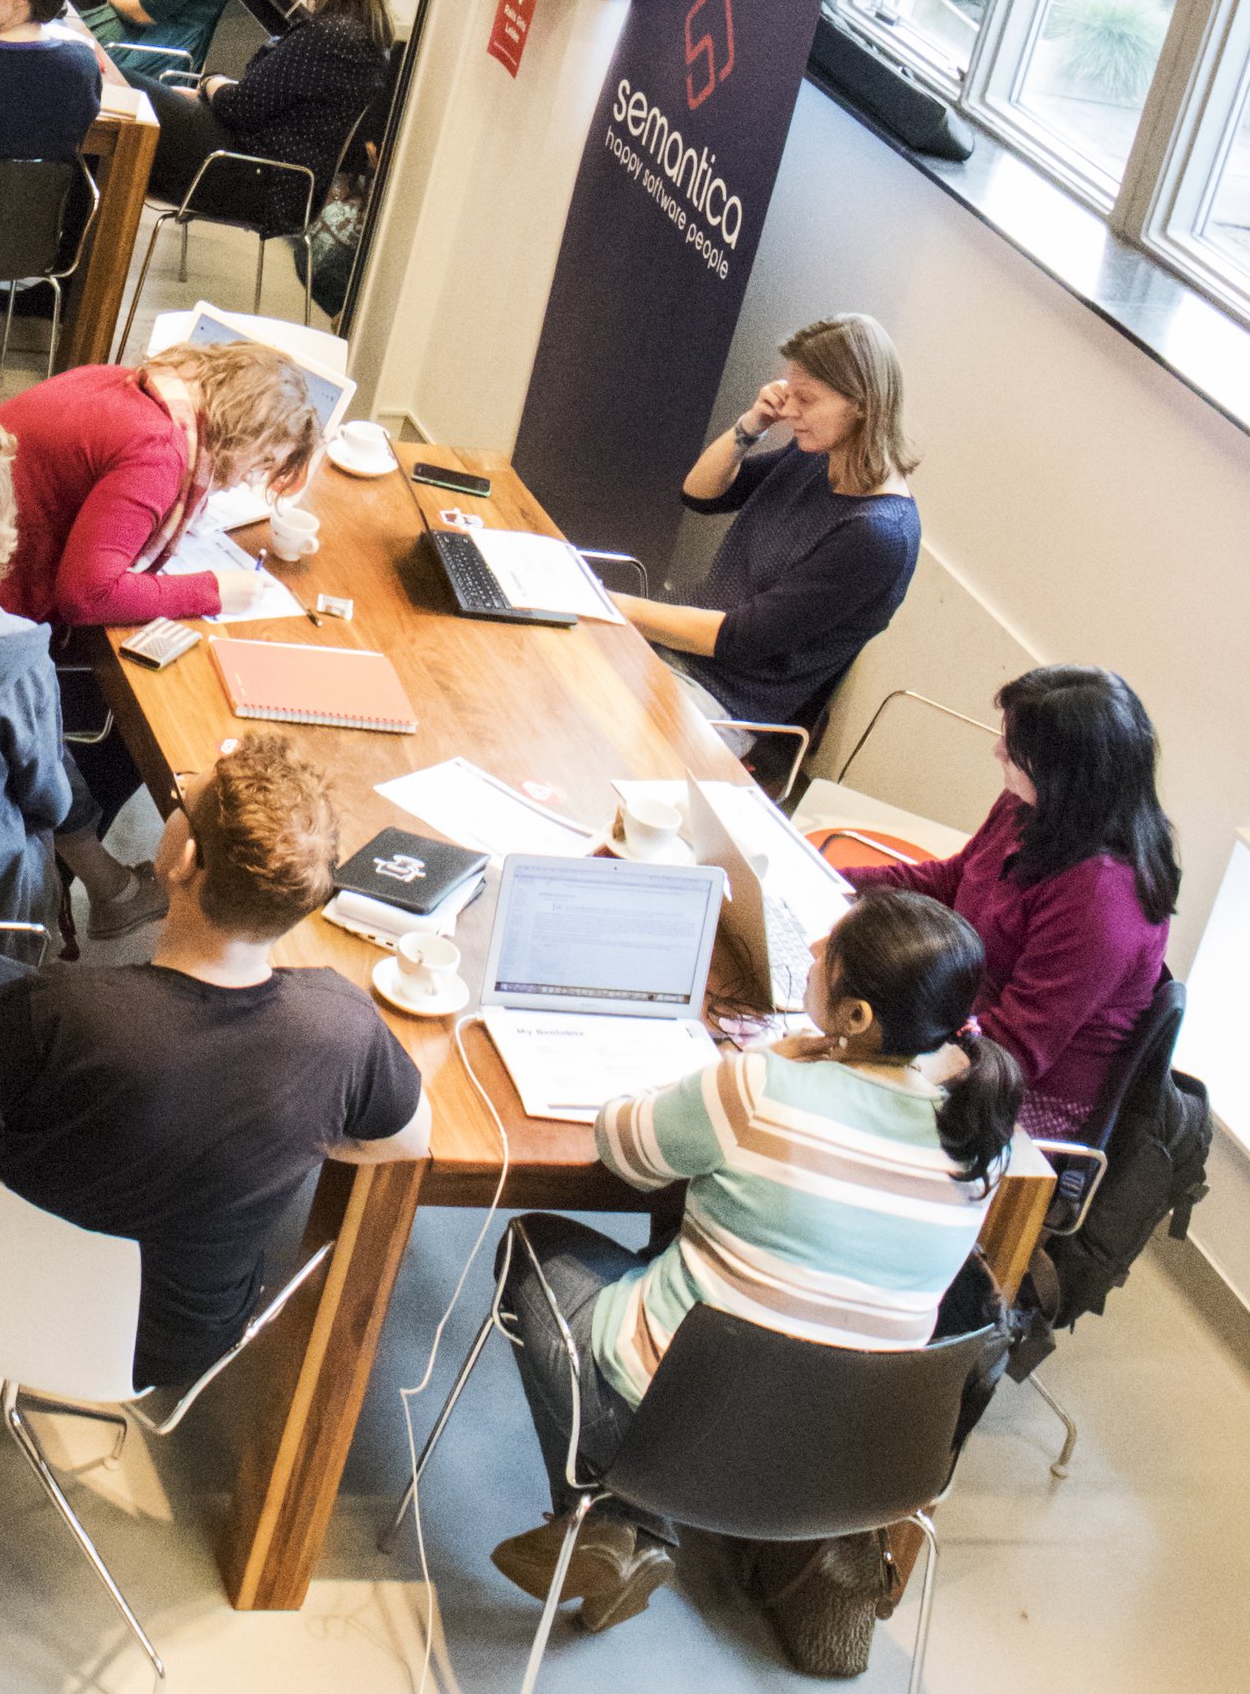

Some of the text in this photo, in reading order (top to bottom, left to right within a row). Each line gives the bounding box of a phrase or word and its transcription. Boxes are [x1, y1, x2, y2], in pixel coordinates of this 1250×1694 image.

[605, 125, 729, 280] happy software people
[613, 79, 742, 250] semantica
